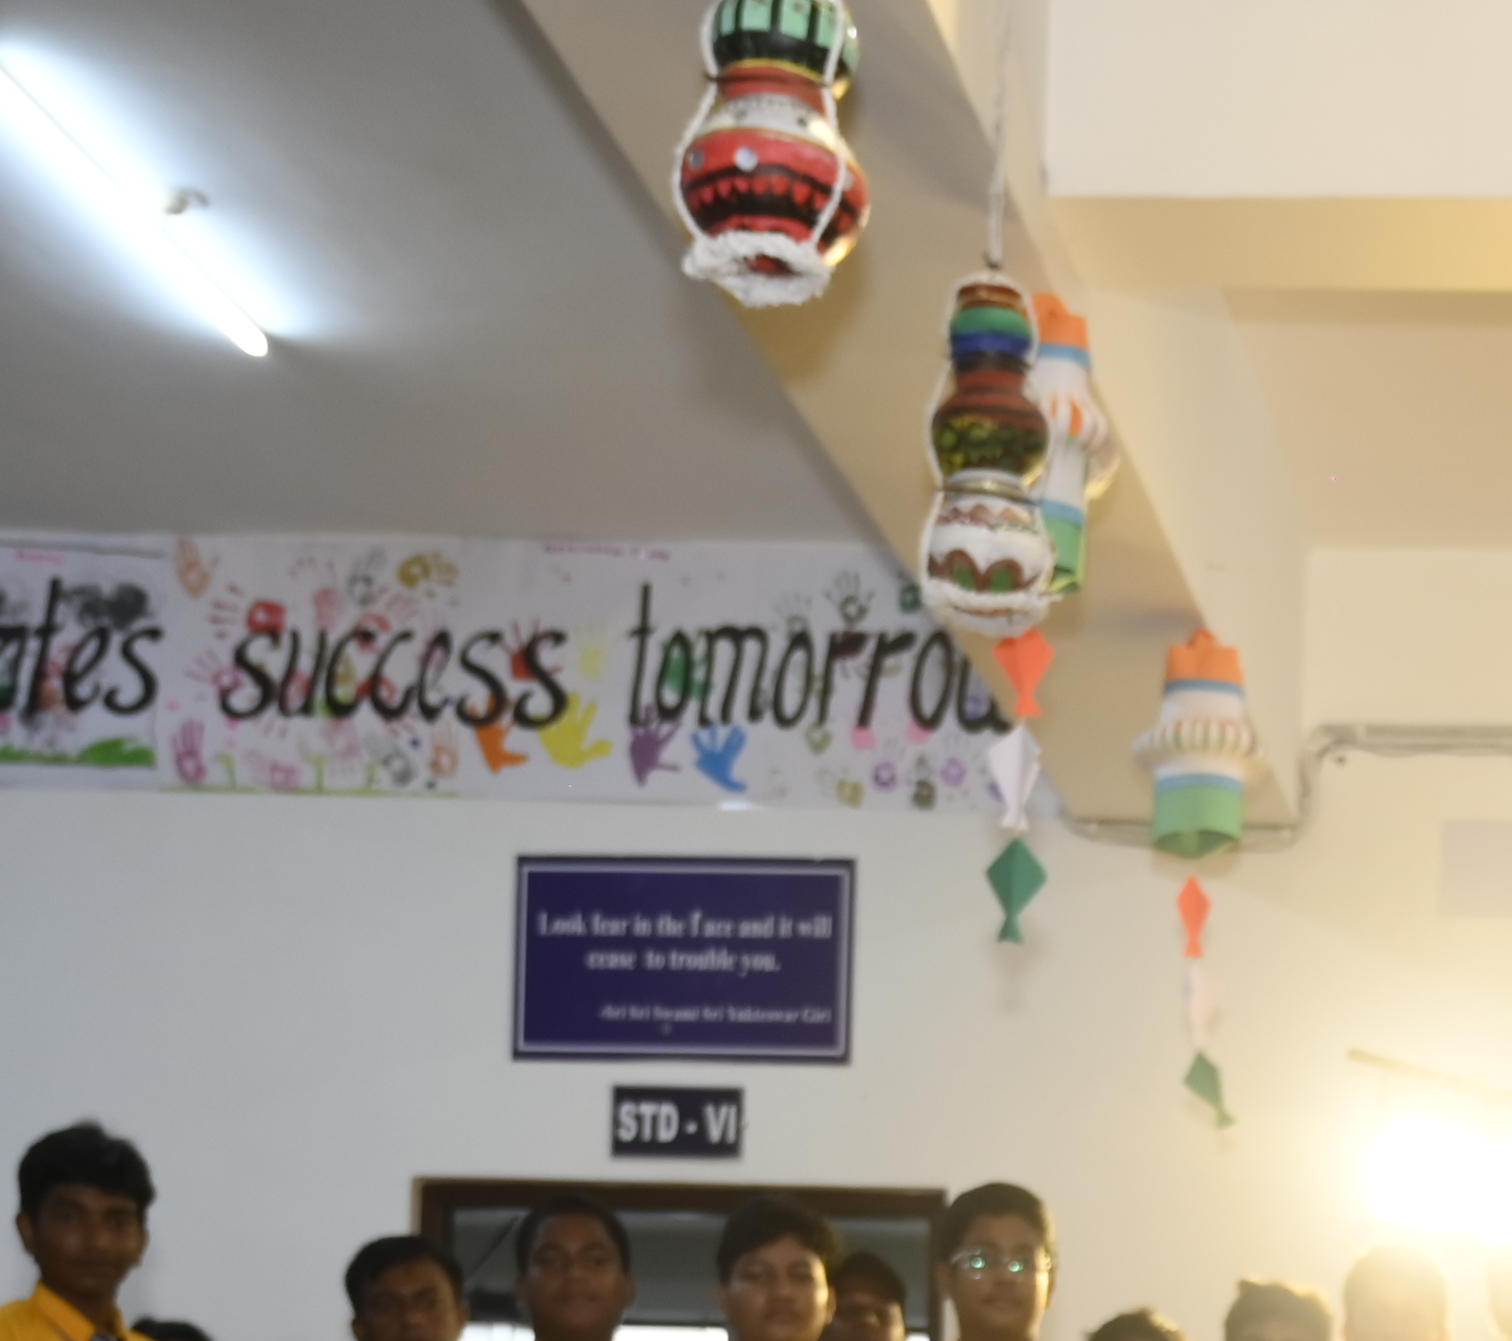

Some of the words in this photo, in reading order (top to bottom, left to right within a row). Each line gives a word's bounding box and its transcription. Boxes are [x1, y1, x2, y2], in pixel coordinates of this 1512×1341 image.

[218, 628, 568, 728] success
[537, 910, 587, 937] Look
[737, 913, 775, 939] and
[645, 948, 666, 971] to
[668, 948, 735, 972] trouble
[617, 1100, 679, 1143] STD
[701, 1102, 738, 1145] VI
